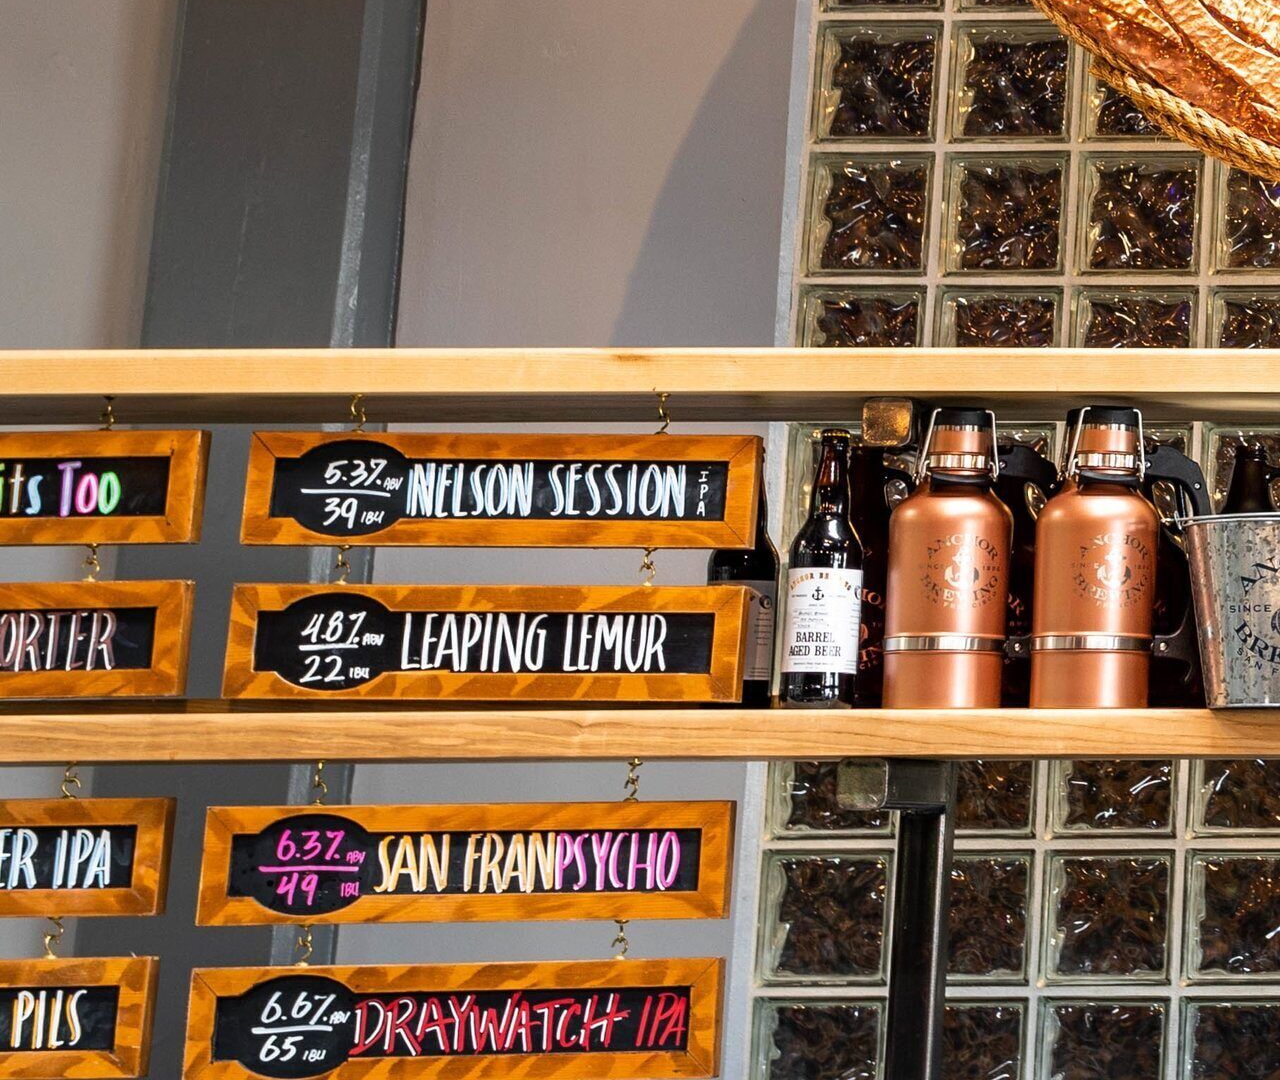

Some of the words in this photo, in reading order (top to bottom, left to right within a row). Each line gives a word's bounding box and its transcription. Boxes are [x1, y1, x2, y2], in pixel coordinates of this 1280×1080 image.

[57, 460, 122, 518] Too
[383, 477, 404, 491] ABV
[406, 462, 534, 517] NELSON
[548, 462, 686, 517] SESSION
[322, 497, 358, 529] 39
[1073, 573, 1148, 601] BREING
[1229, 604, 1272, 613] SINCE
[361, 632, 385, 646] ABV
[400, 613, 549, 673] LEAPING
[563, 613, 667, 672] LEMUR
[788, 645, 810, 657] AGED
[815, 645, 841, 657] BEER
[795, 631, 835, 643] BARREL
[299, 655, 345, 683] 22
[1236, 647, 1263, 670] SAN
[52, 829, 111, 890] IPA
[346, 850, 366, 864] ABV
[373, 833, 450, 892] SAN
[463, 831, 681, 893] FRANPSYCHO
[276, 872, 319, 906] 49
[10, 989, 87, 1050] PILS
[329, 1011, 351, 1024] ABV
[348, 990, 631, 1056] DRAYWATCH
[635, 992, 687, 1048] IPA
[259, 1035, 304, 1062] 65
